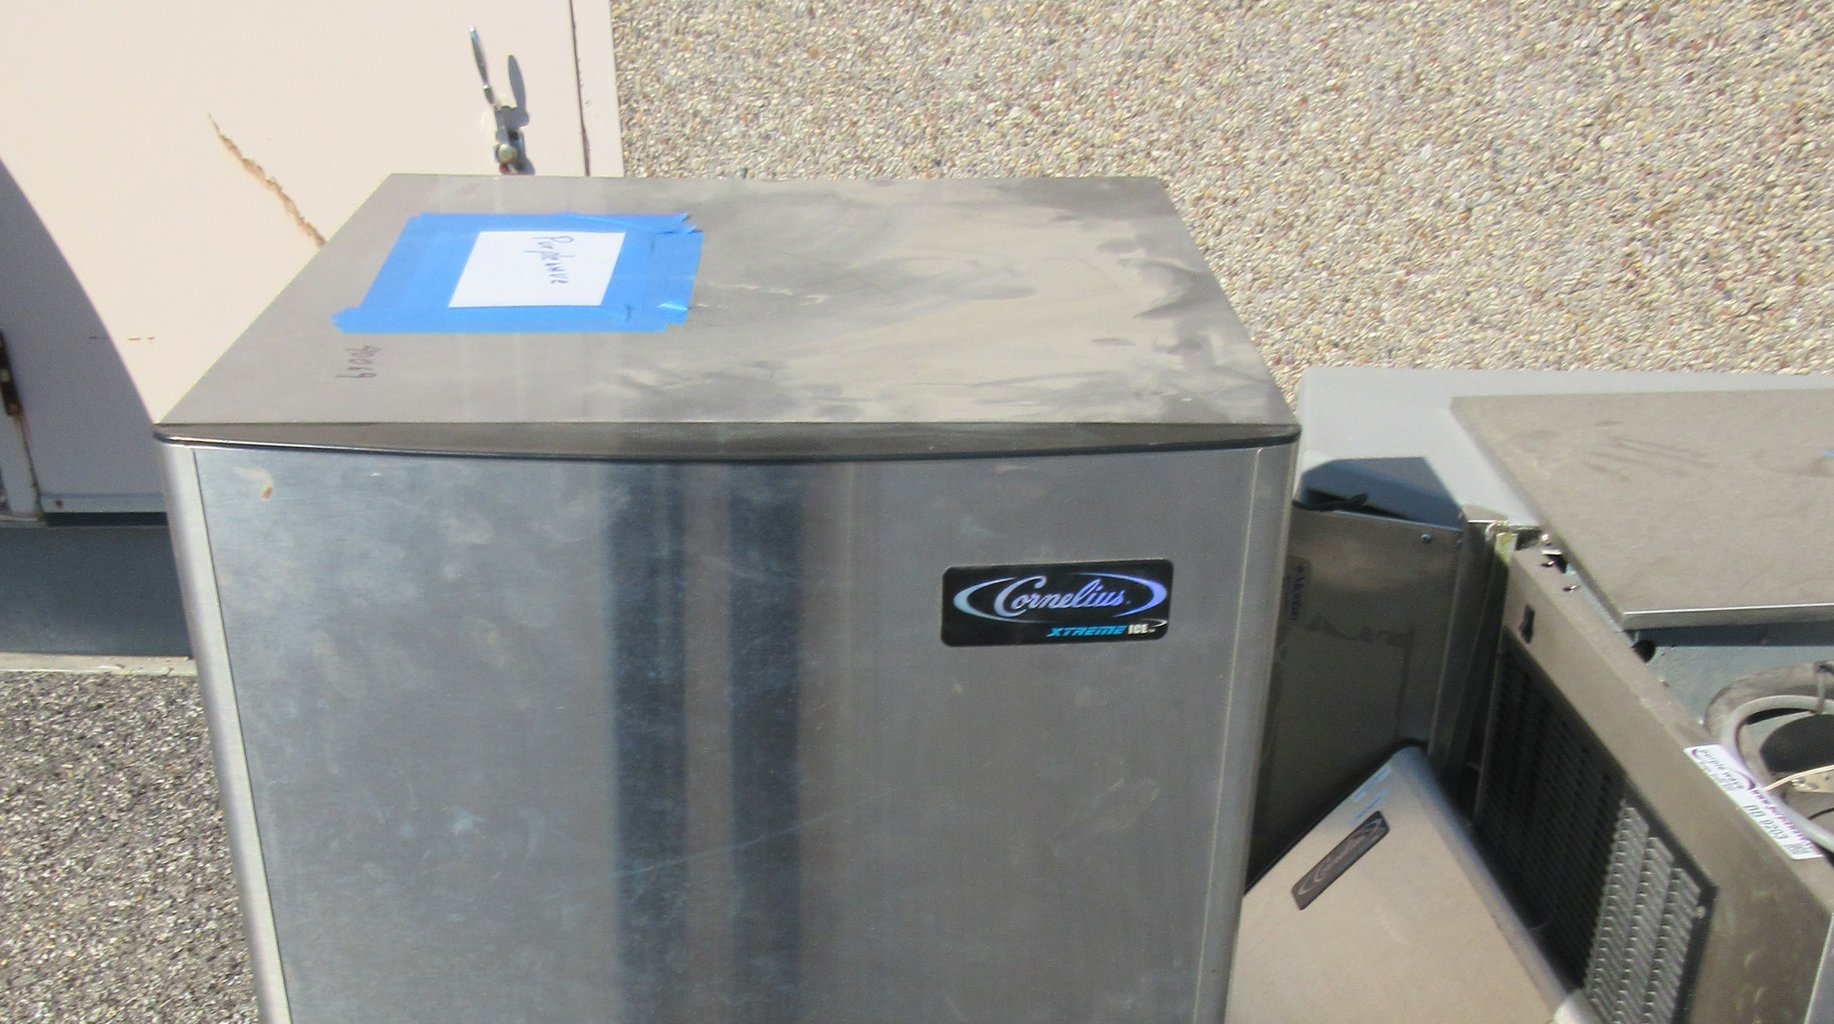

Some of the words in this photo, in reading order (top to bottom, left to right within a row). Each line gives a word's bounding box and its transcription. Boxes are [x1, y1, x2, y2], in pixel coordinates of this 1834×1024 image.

[994, 575, 1126, 618] Cornelius
[1047, 625, 1128, 638] XTREME
[1128, 623, 1149, 635] ICE
